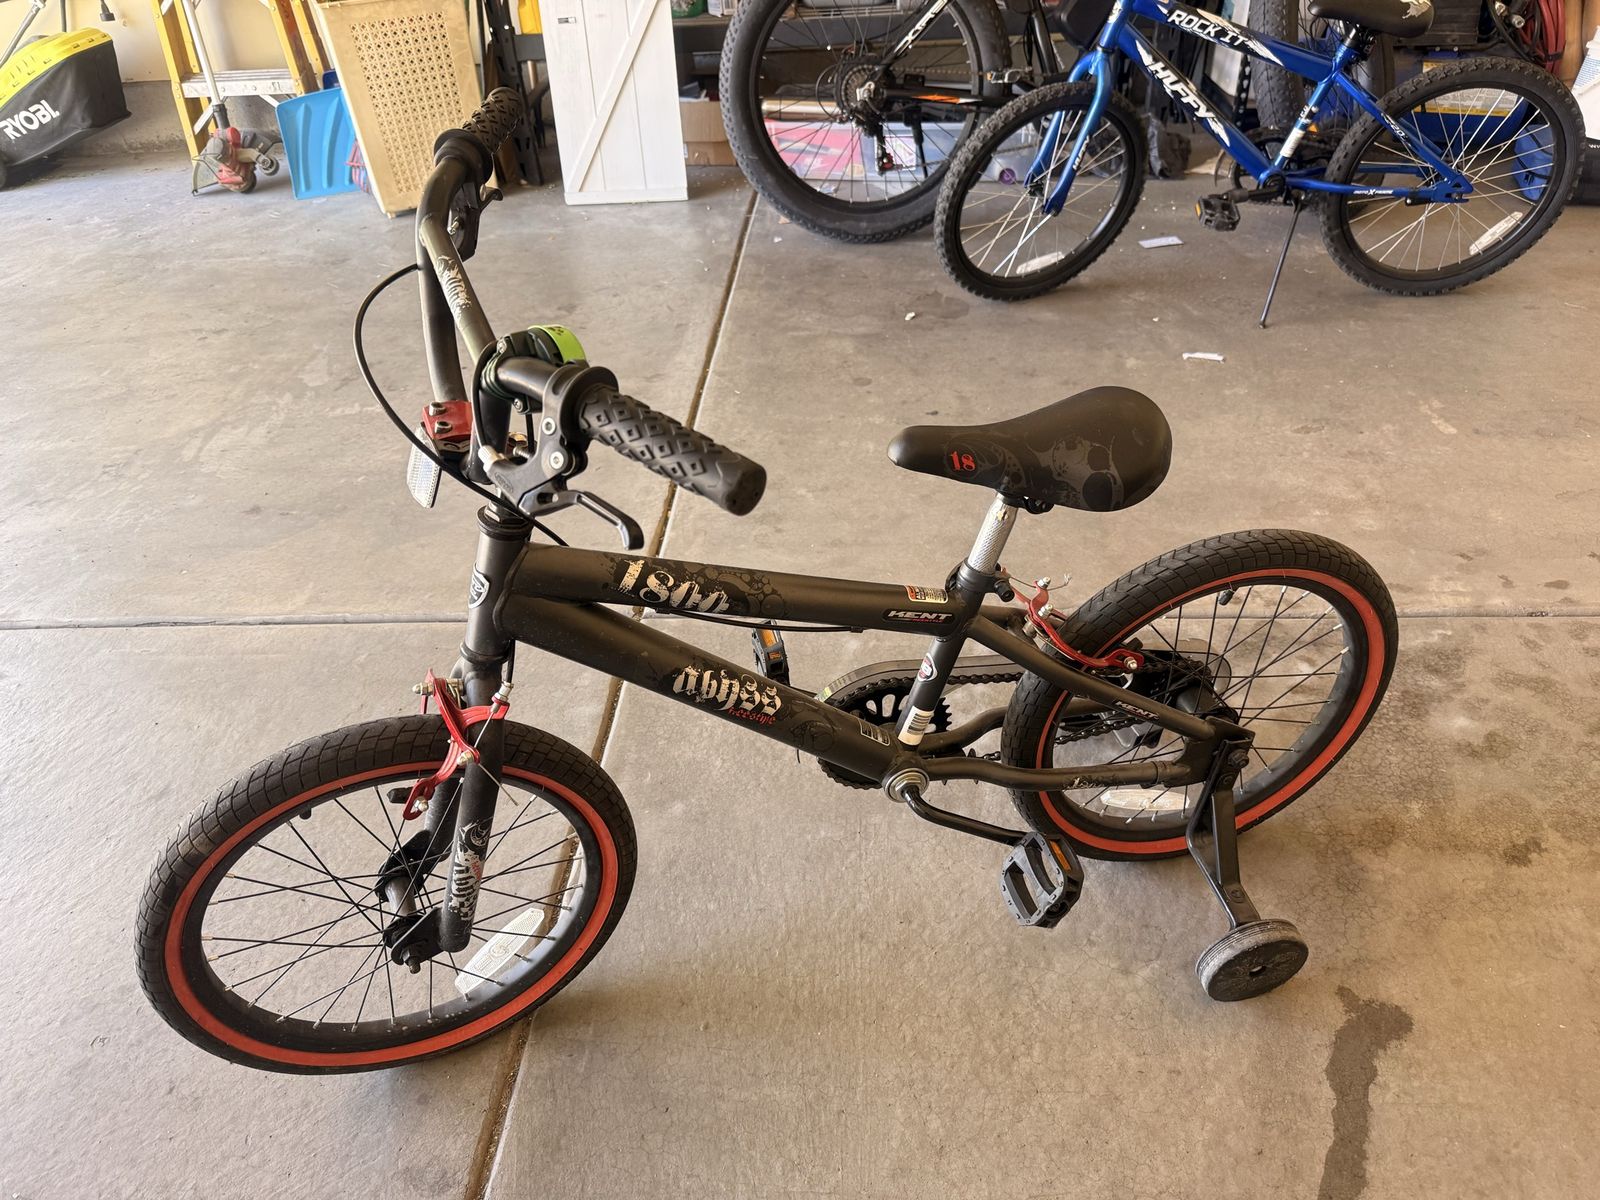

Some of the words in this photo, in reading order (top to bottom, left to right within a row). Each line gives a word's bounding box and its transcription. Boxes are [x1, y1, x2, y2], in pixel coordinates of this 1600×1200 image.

[1167, 9, 1221, 37] ROCK
[1220, 30, 1248, 46] IT
[1148, 61, 1216, 118] HUFFY
[0, 99, 60, 140] RYOBI
[950, 451, 976, 471] 18
[888, 610, 952, 620] KENT
[672, 665, 782, 717] abyss
[1115, 700, 1159, 719] KENT
